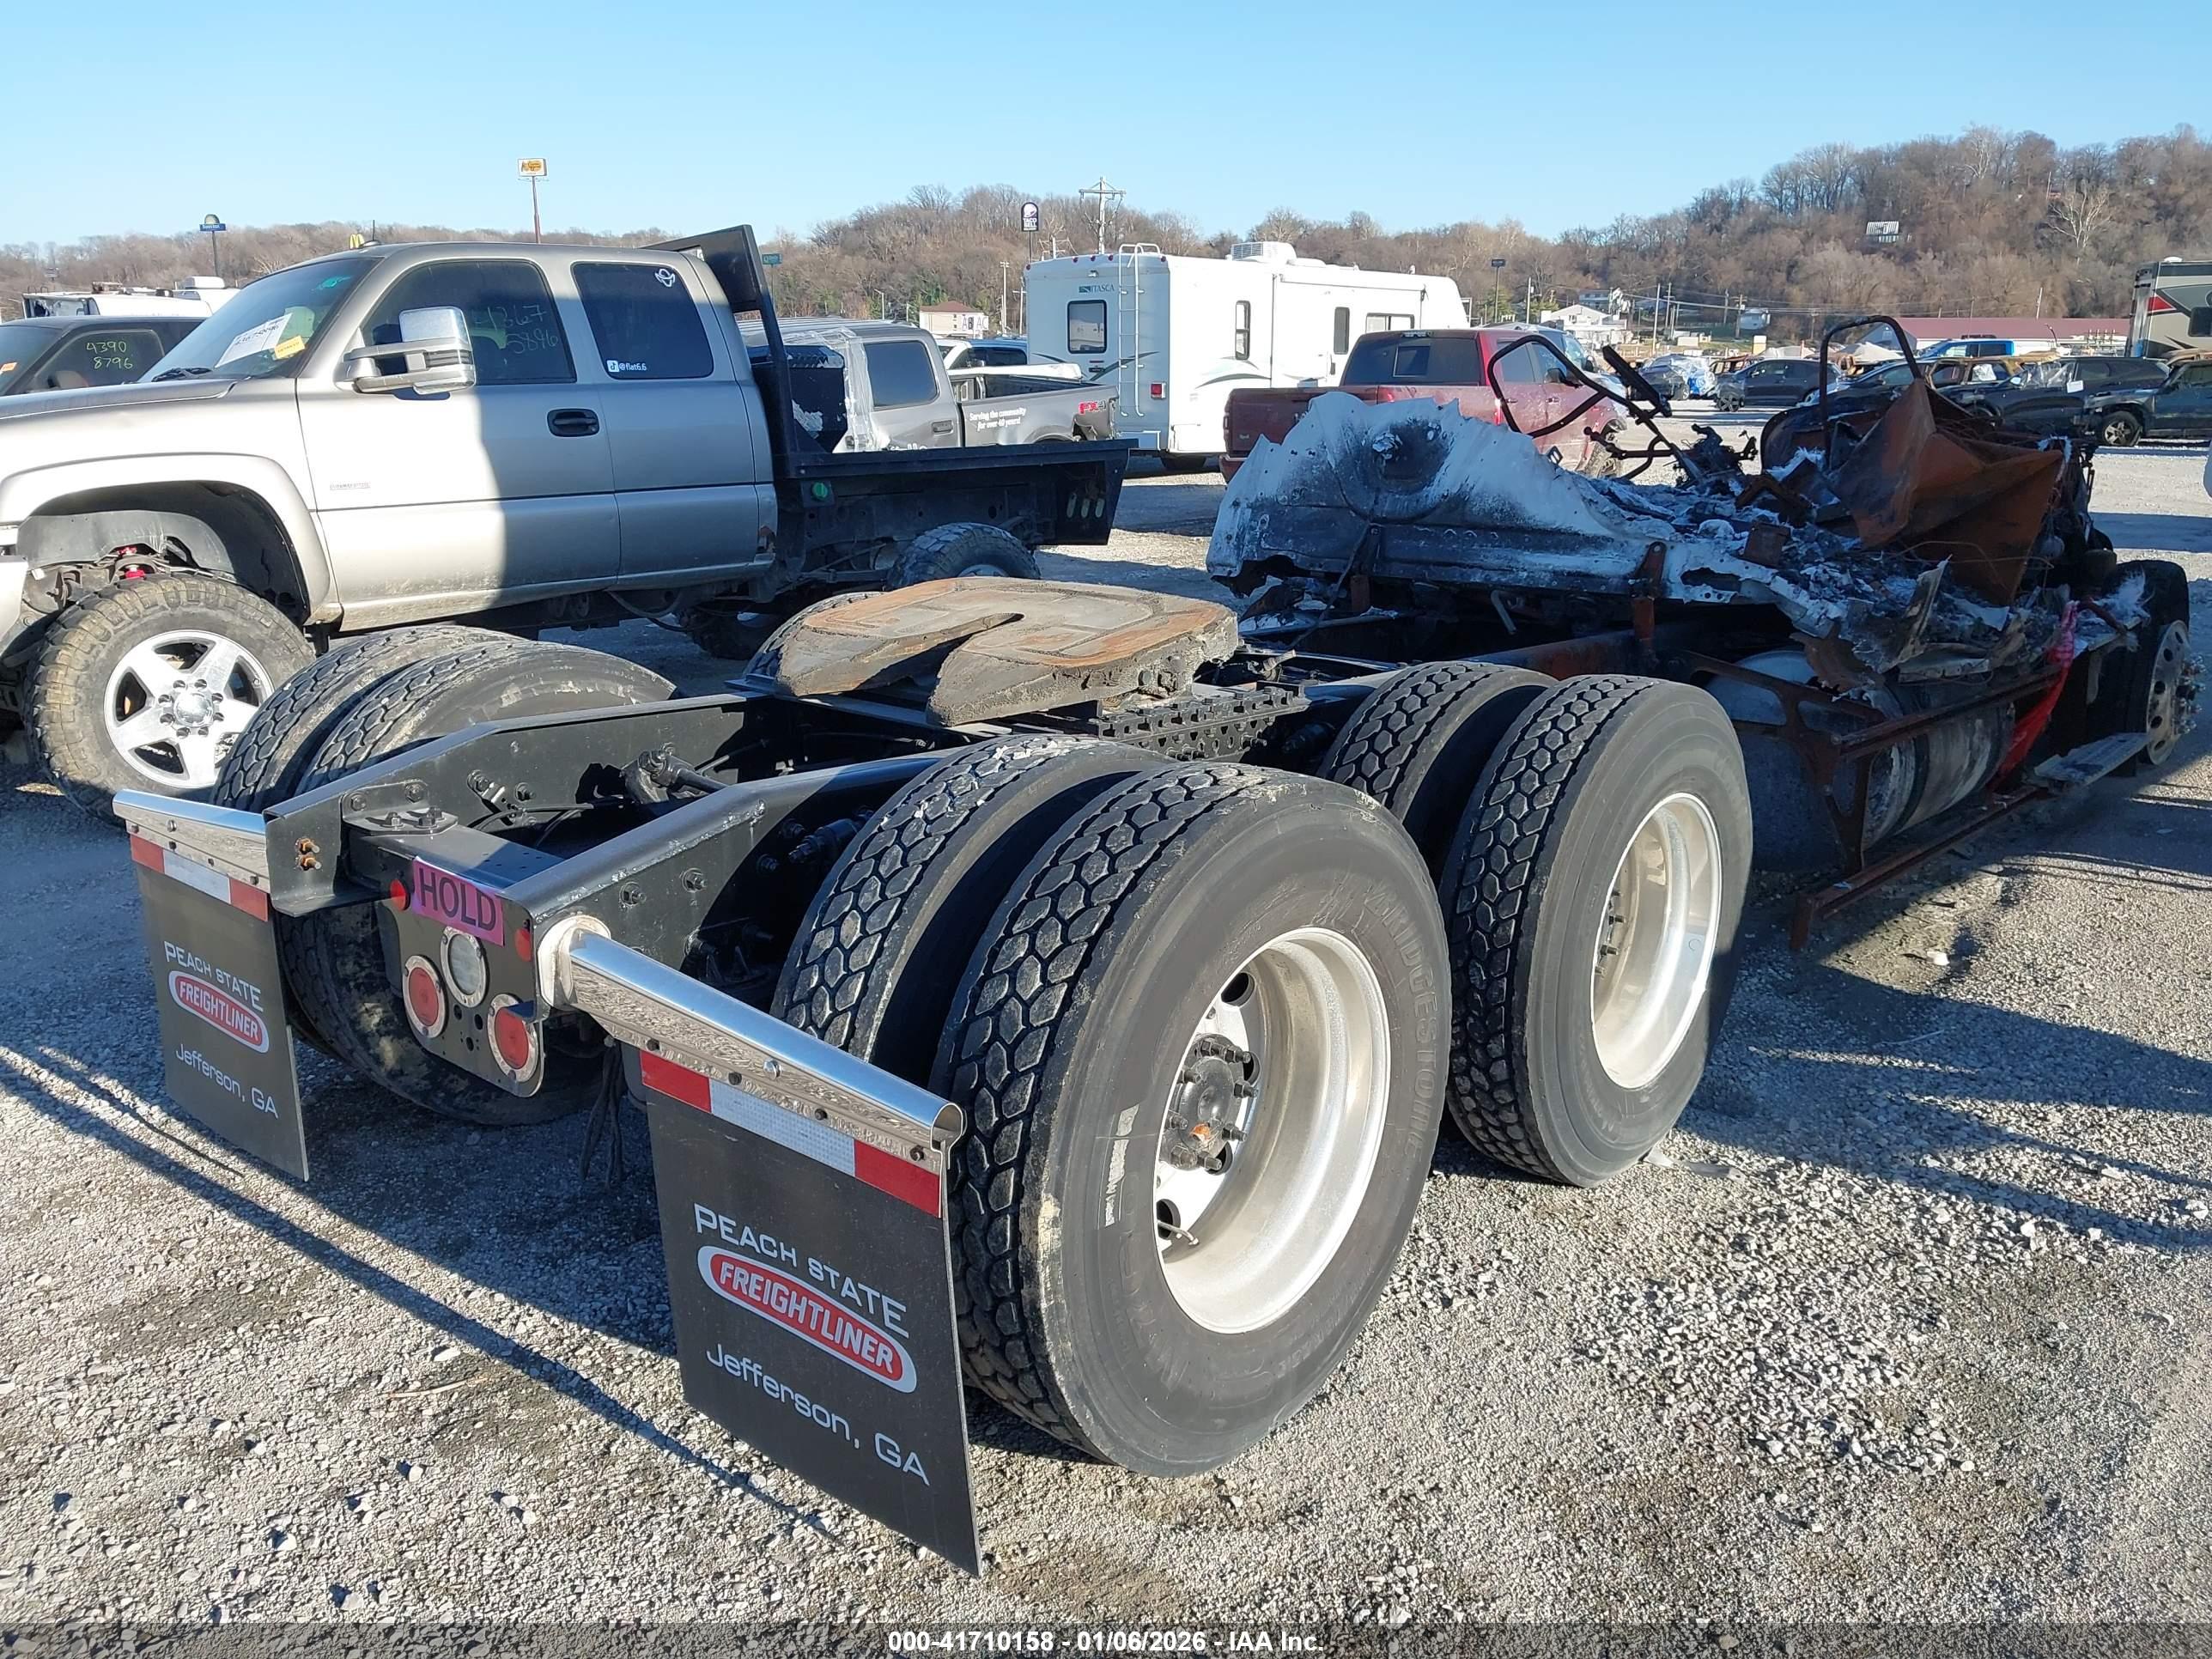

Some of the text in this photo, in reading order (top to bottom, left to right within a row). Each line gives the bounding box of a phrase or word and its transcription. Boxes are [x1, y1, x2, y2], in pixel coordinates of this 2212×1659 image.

[1091, 284, 1115, 293] ITASCA
[86, 341, 126, 354] 4390
[93, 356, 133, 369] 8796
[969, 410, 989, 422] Serving
[998, 407, 1026, 417] community
[976, 420, 987, 432] for
[1079, 400, 1107, 414] FX4
[418, 867, 496, 932] HOLD
[164, 940, 264, 1012] PEACH STATE
[179, 981, 258, 1042] FREIGHTLINER
[175, 1043, 279, 1119] Jefferson, GA
[694, 1202, 909, 1340] PEACH STATE
[719, 1263, 894, 1374] FREIGHTLINER
[706, 1343, 931, 1487] Jefferson, GA
